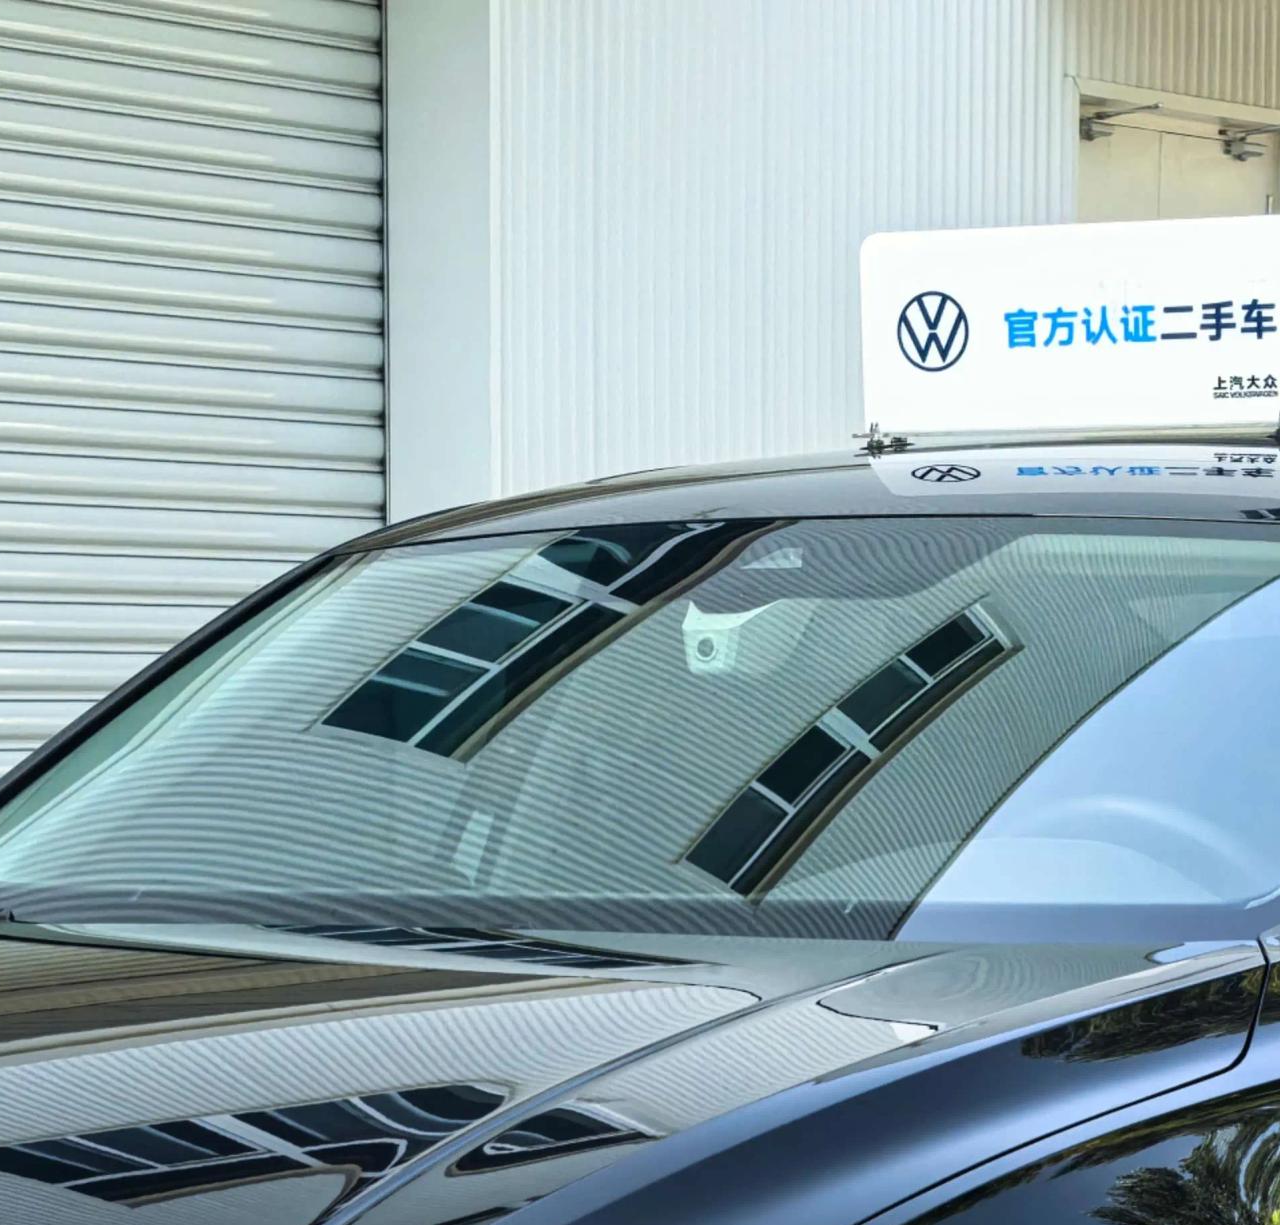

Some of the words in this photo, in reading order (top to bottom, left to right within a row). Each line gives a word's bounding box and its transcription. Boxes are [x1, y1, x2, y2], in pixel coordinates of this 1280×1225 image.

[1004, 299, 1277, 348] 官方认证二手车
[1213, 374, 1278, 390] 上汽大众
